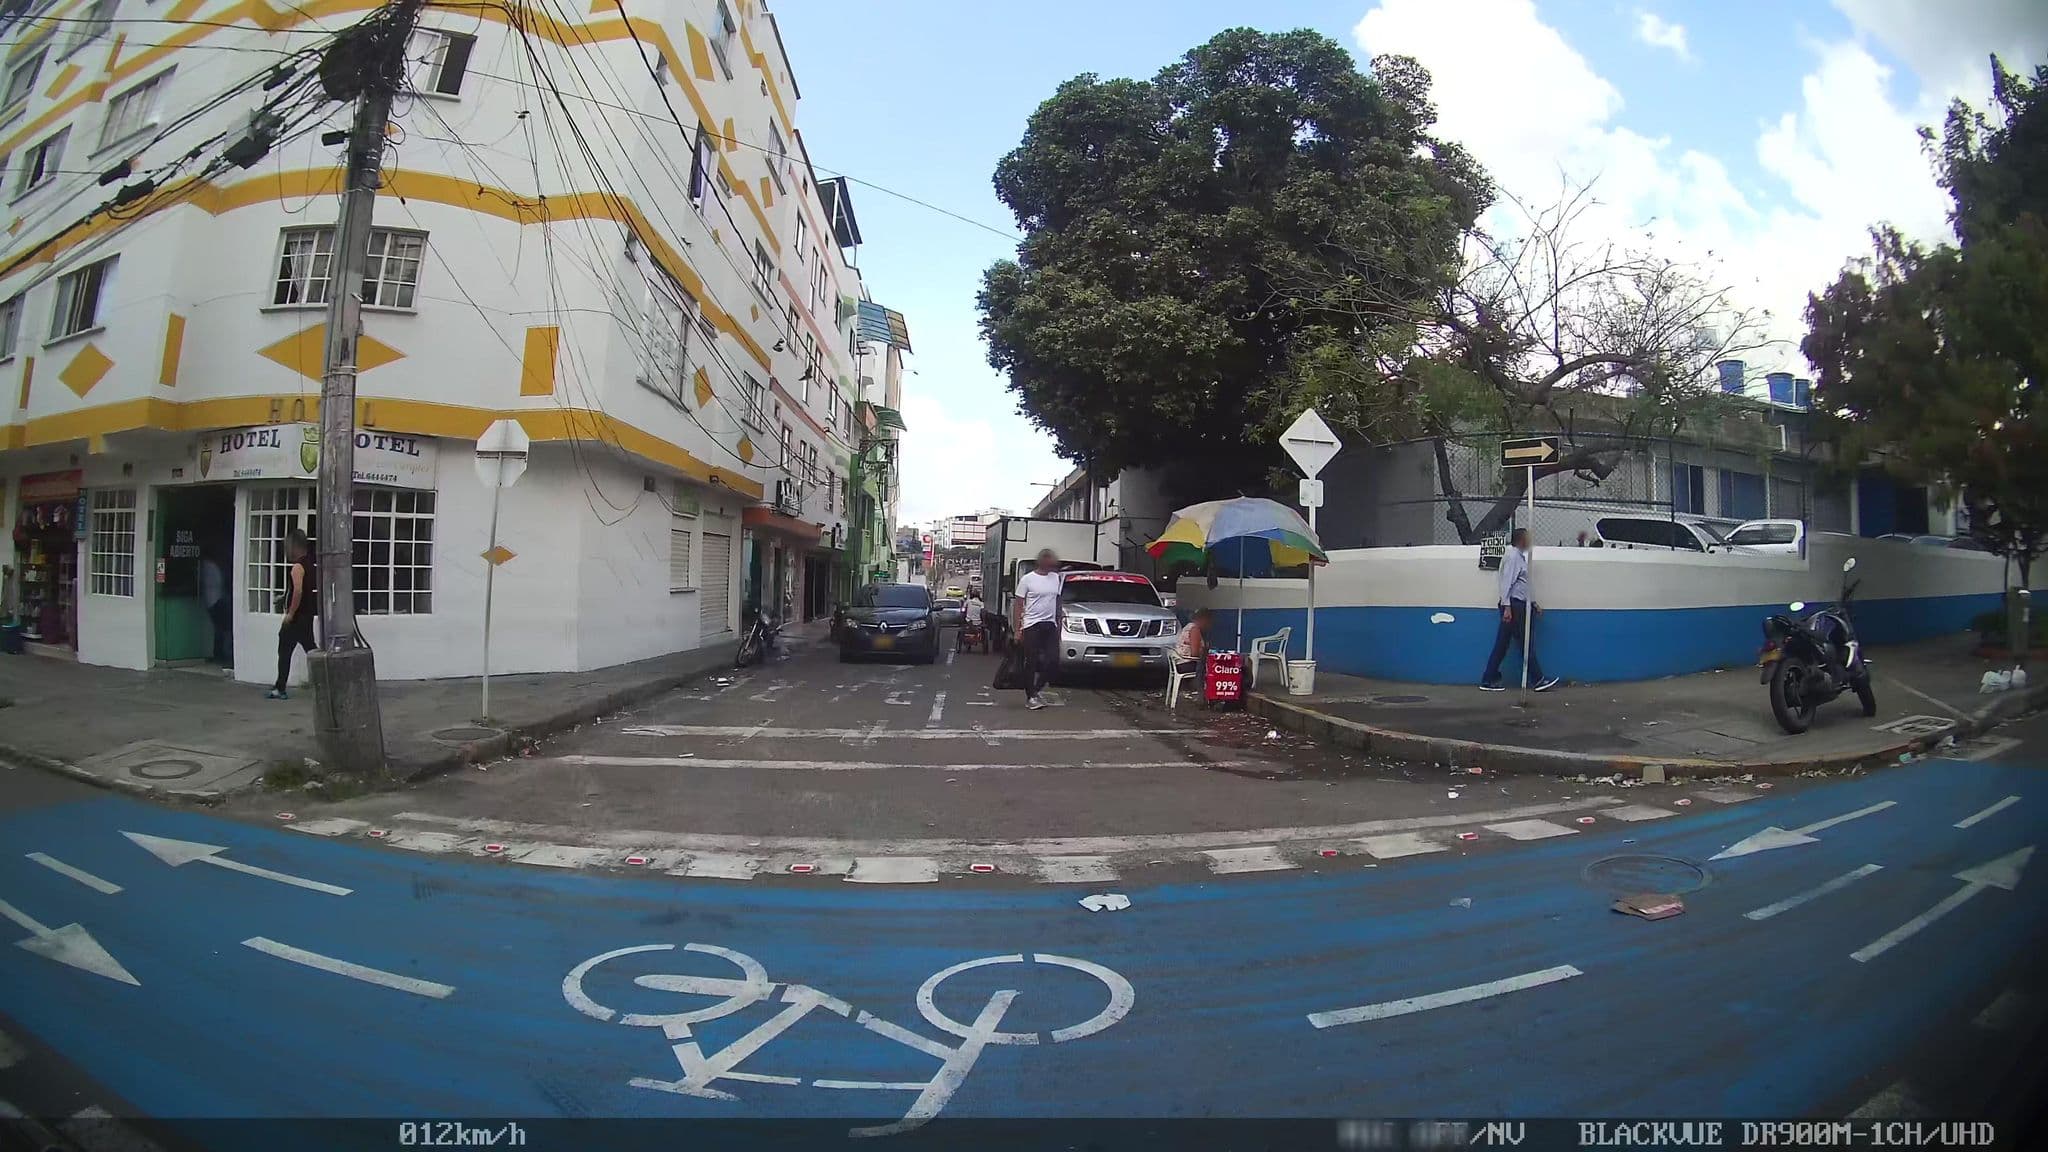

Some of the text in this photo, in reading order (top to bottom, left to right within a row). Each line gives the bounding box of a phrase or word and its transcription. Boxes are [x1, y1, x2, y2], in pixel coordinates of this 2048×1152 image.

[219, 429, 281, 454] HOTEL
[354, 433, 420, 457] OTEL
[1214, 665, 1240, 674] Claro
[1215, 681, 1238, 691] 99%
